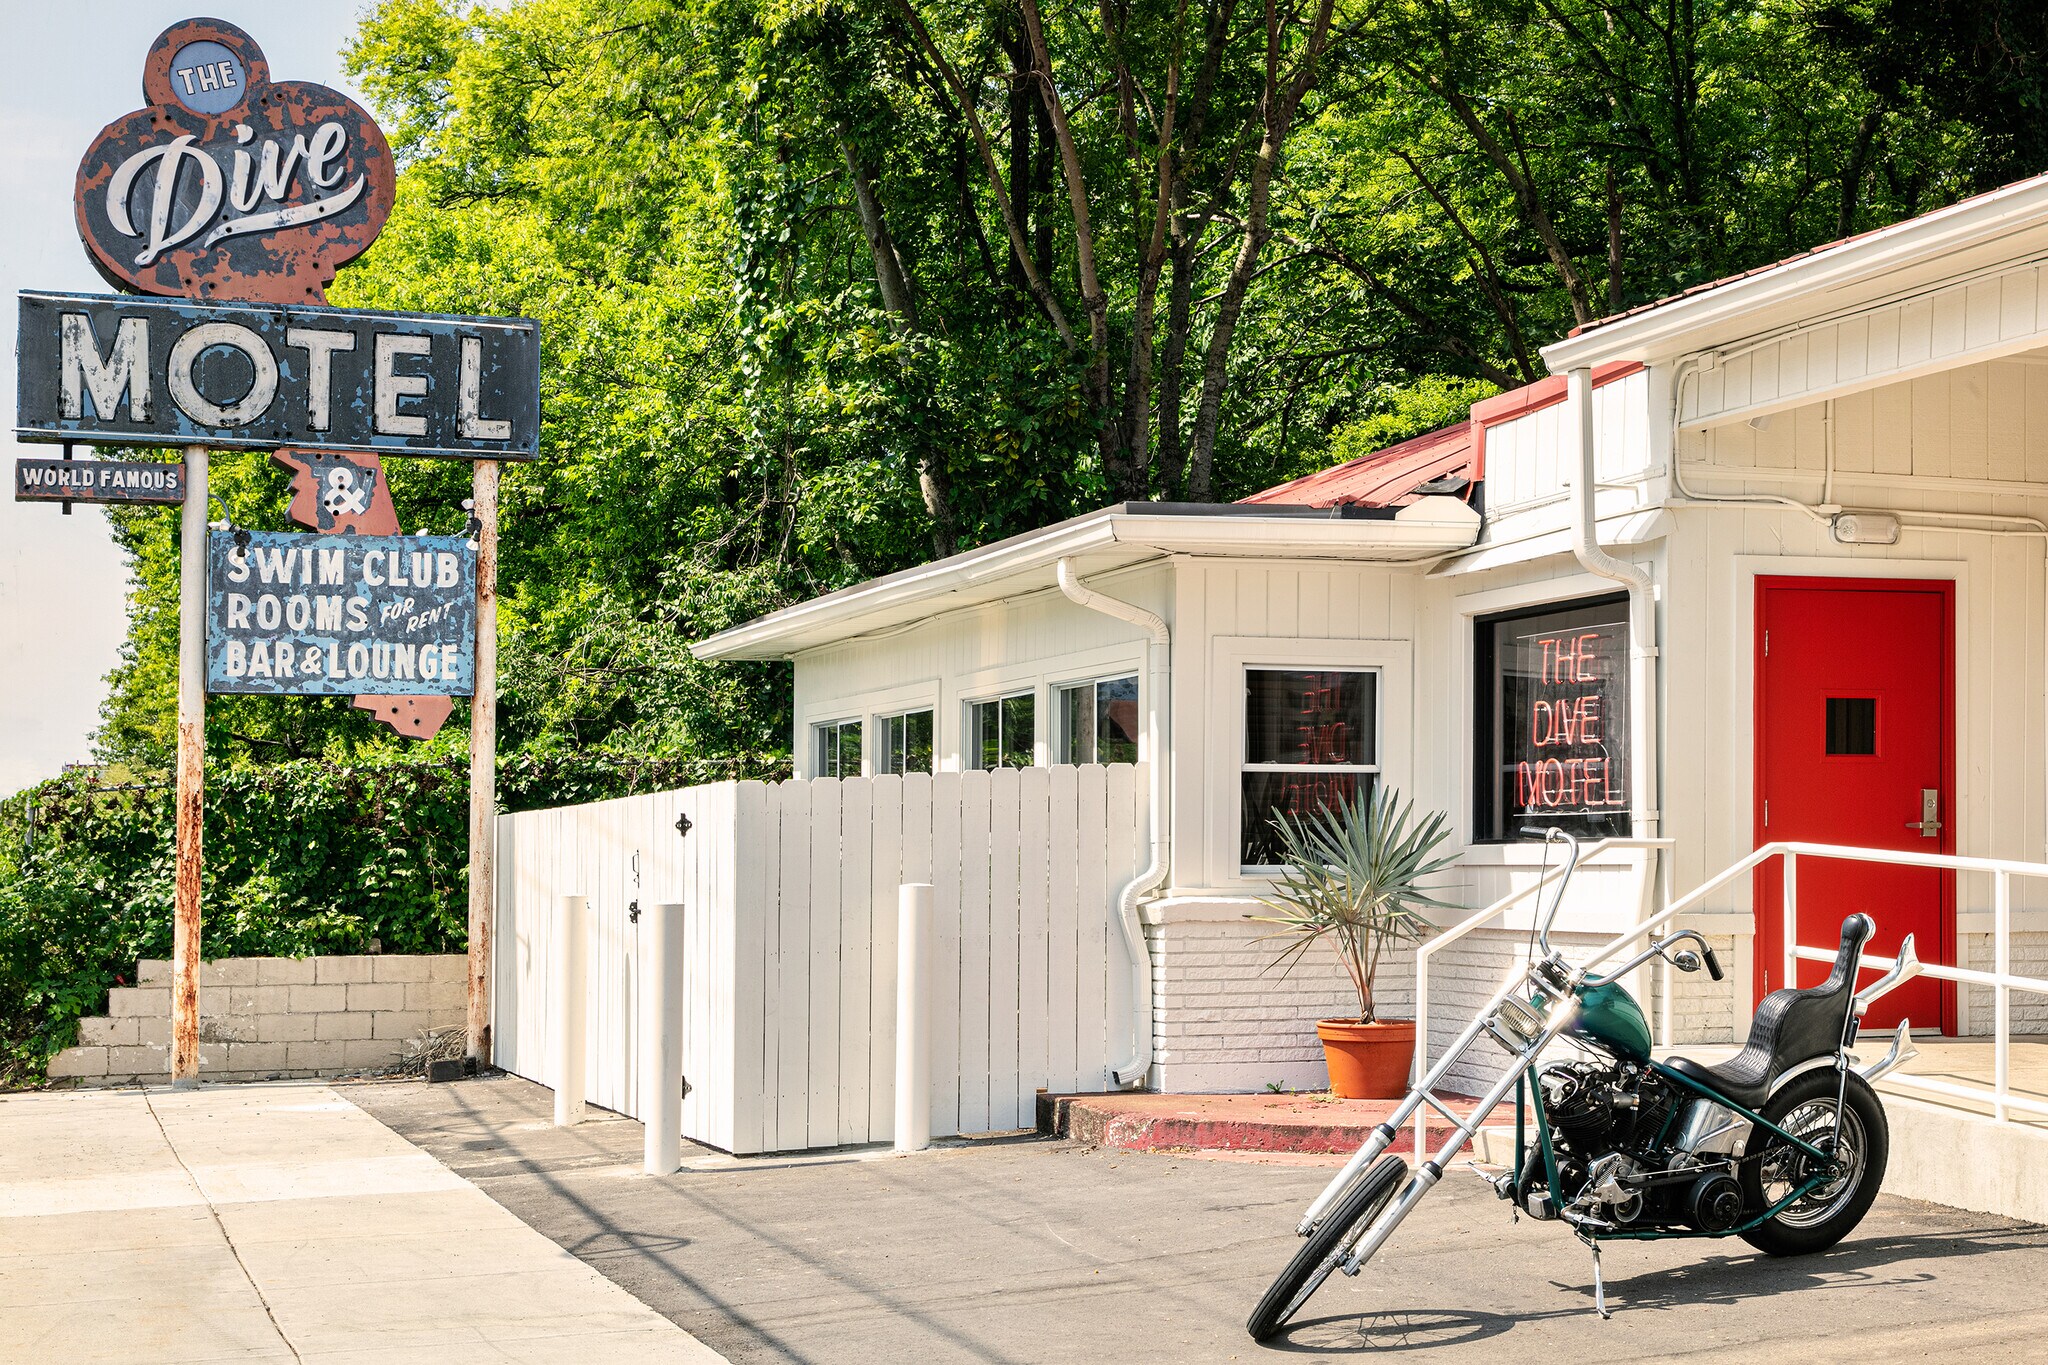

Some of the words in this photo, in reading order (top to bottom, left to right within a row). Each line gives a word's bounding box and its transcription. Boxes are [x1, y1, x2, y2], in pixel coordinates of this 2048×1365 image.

[177, 59, 238, 95] THE
[105, 121, 365, 267] Dive
[59, 312, 513, 441] MOTEL
[22, 467, 95, 487] WORLD
[101, 470, 178, 489] FAMOUS
[324, 466, 366, 516] &
[227, 547, 345, 585] SWIM
[362, 550, 460, 588] CLUB
[227, 592, 370, 632] ROOMS
[381, 597, 415, 624] FOR
[405, 602, 454, 634] RENT
[227, 640, 295, 678] BAR
[300, 646, 323, 675] &
[329, 643, 459, 680] LOUNGE
[1537, 633, 1599, 685] THE
[1532, 695, 1603, 747] DIVE
[1516, 757, 1627, 808] MOTEL
